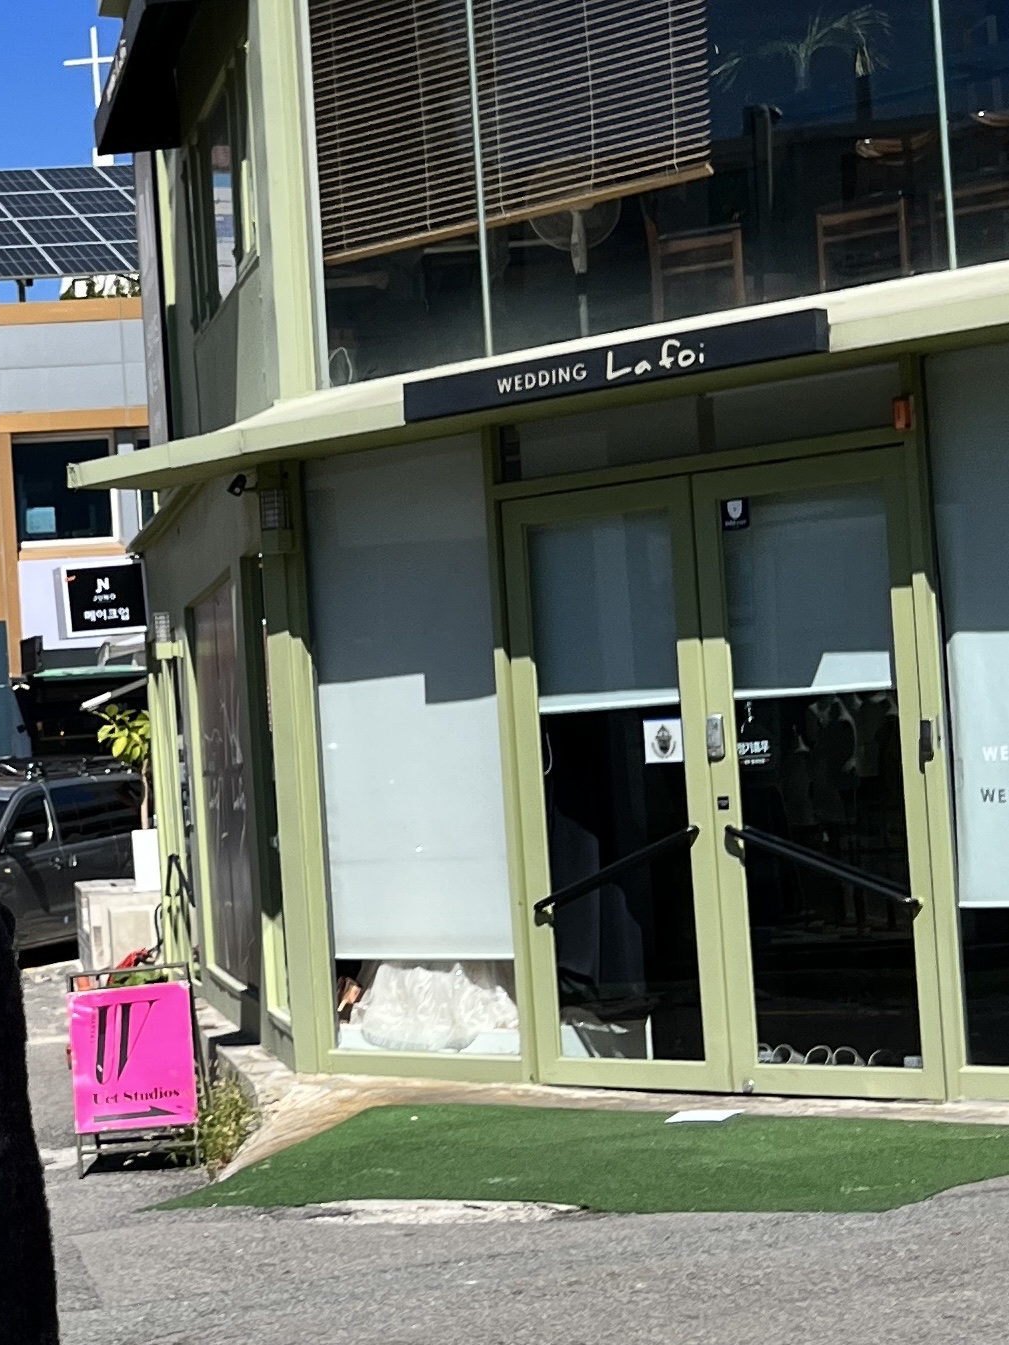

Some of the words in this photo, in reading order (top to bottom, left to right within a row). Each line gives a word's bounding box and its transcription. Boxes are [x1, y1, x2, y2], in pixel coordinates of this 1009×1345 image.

[497, 362, 587, 394] WEDDING
[83, 606, 130, 622] 메이크업
[123, 1086, 180, 1101] Studios
